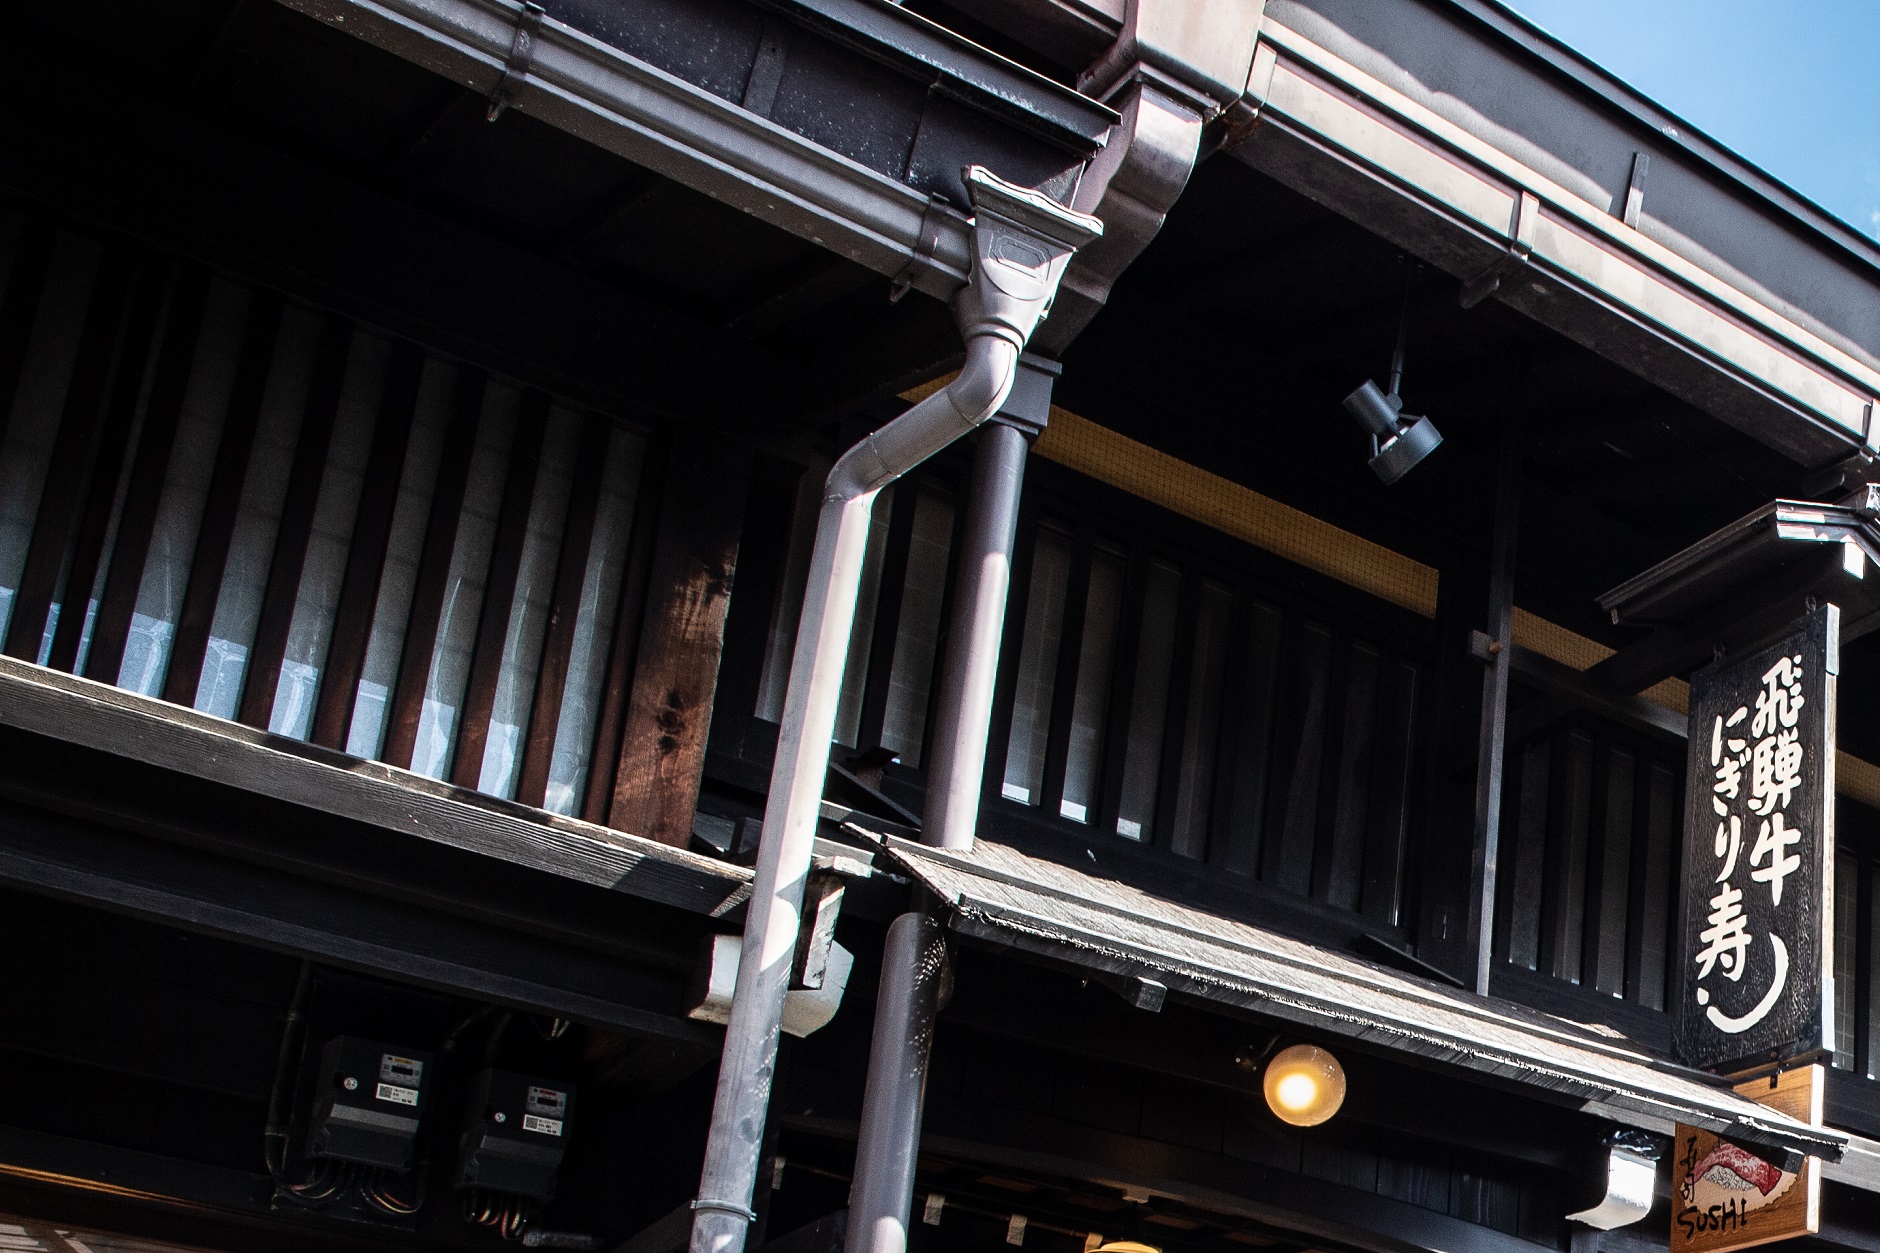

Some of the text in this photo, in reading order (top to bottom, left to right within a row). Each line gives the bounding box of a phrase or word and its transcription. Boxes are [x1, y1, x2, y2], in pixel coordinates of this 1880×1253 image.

[1748, 654, 1804, 906] 飛騨牛
[1677, 1198, 1748, 1239] SUSHI
